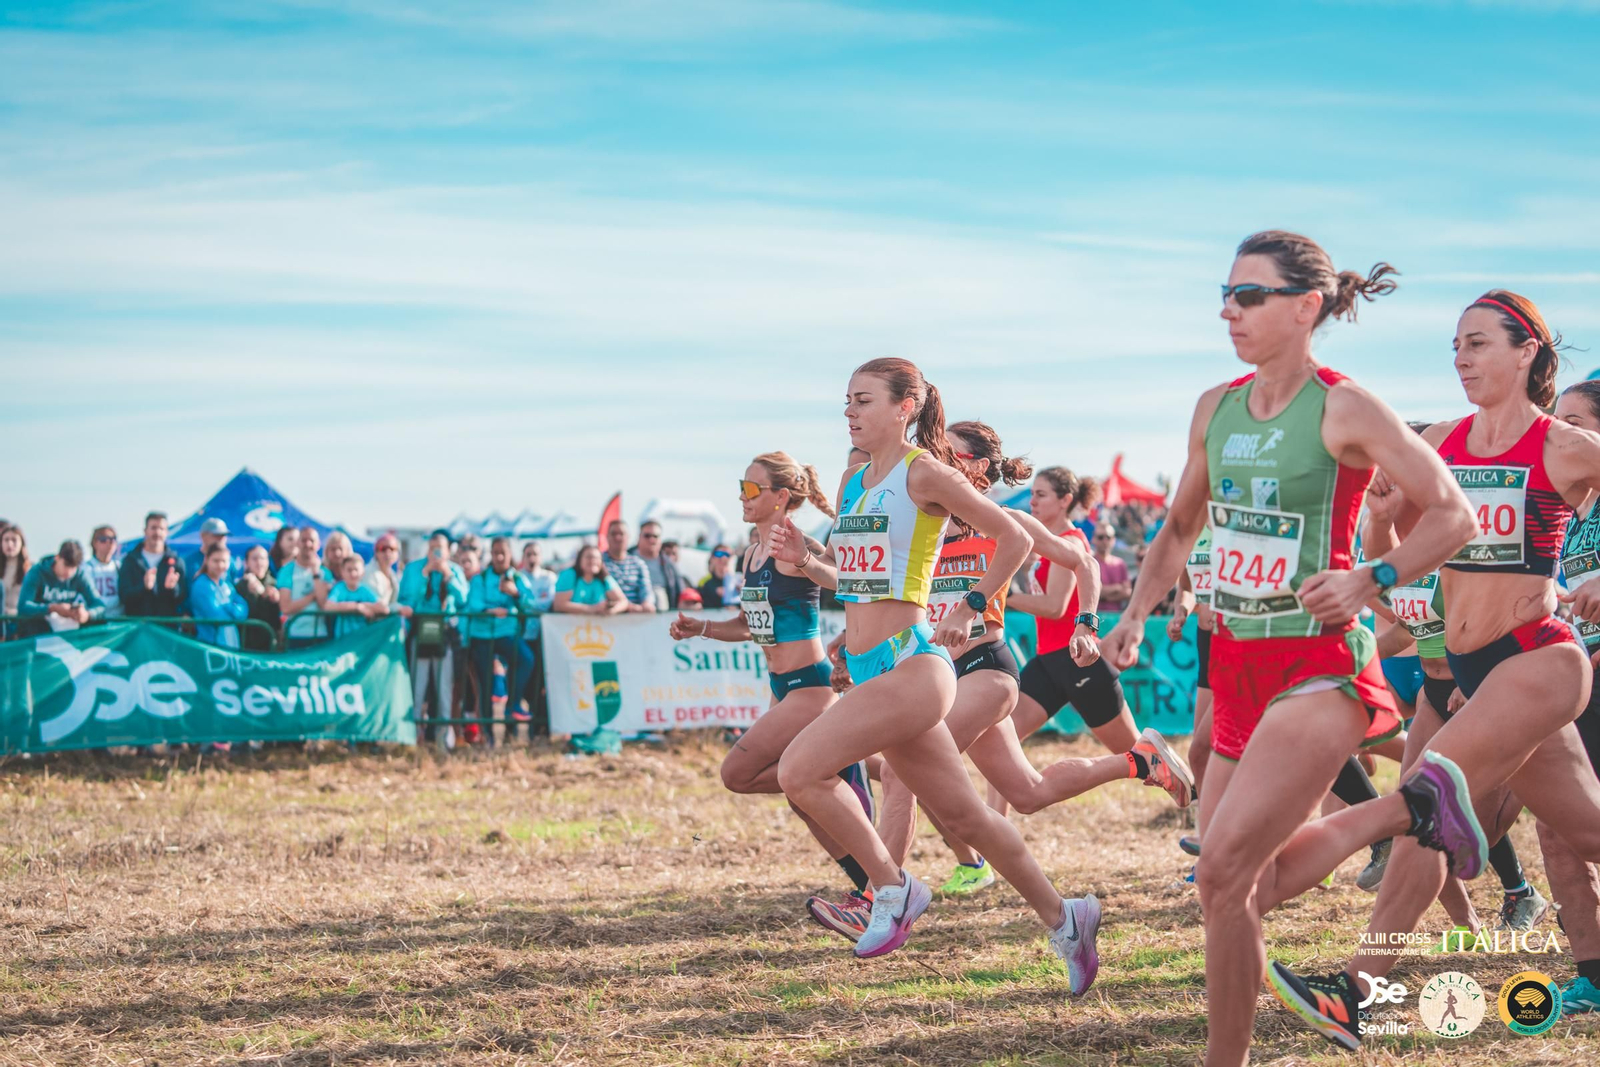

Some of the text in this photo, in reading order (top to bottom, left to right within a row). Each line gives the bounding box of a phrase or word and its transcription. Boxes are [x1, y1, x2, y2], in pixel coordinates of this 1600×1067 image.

[1454, 470, 1498, 482] ITÁLICA
[842, 516, 870, 528] ITÁLICA
[1477, 504, 1516, 536] 40
[838, 545, 887, 572] 2242
[939, 553, 988, 575] ZUBIA
[940, 553, 977, 564] Deportivo
[1217, 546, 1287, 590] 2244
[673, 642, 768, 678] Santip
[212, 675, 365, 715] Sevilla
[644, 705, 760, 723] EL DEPORTE
